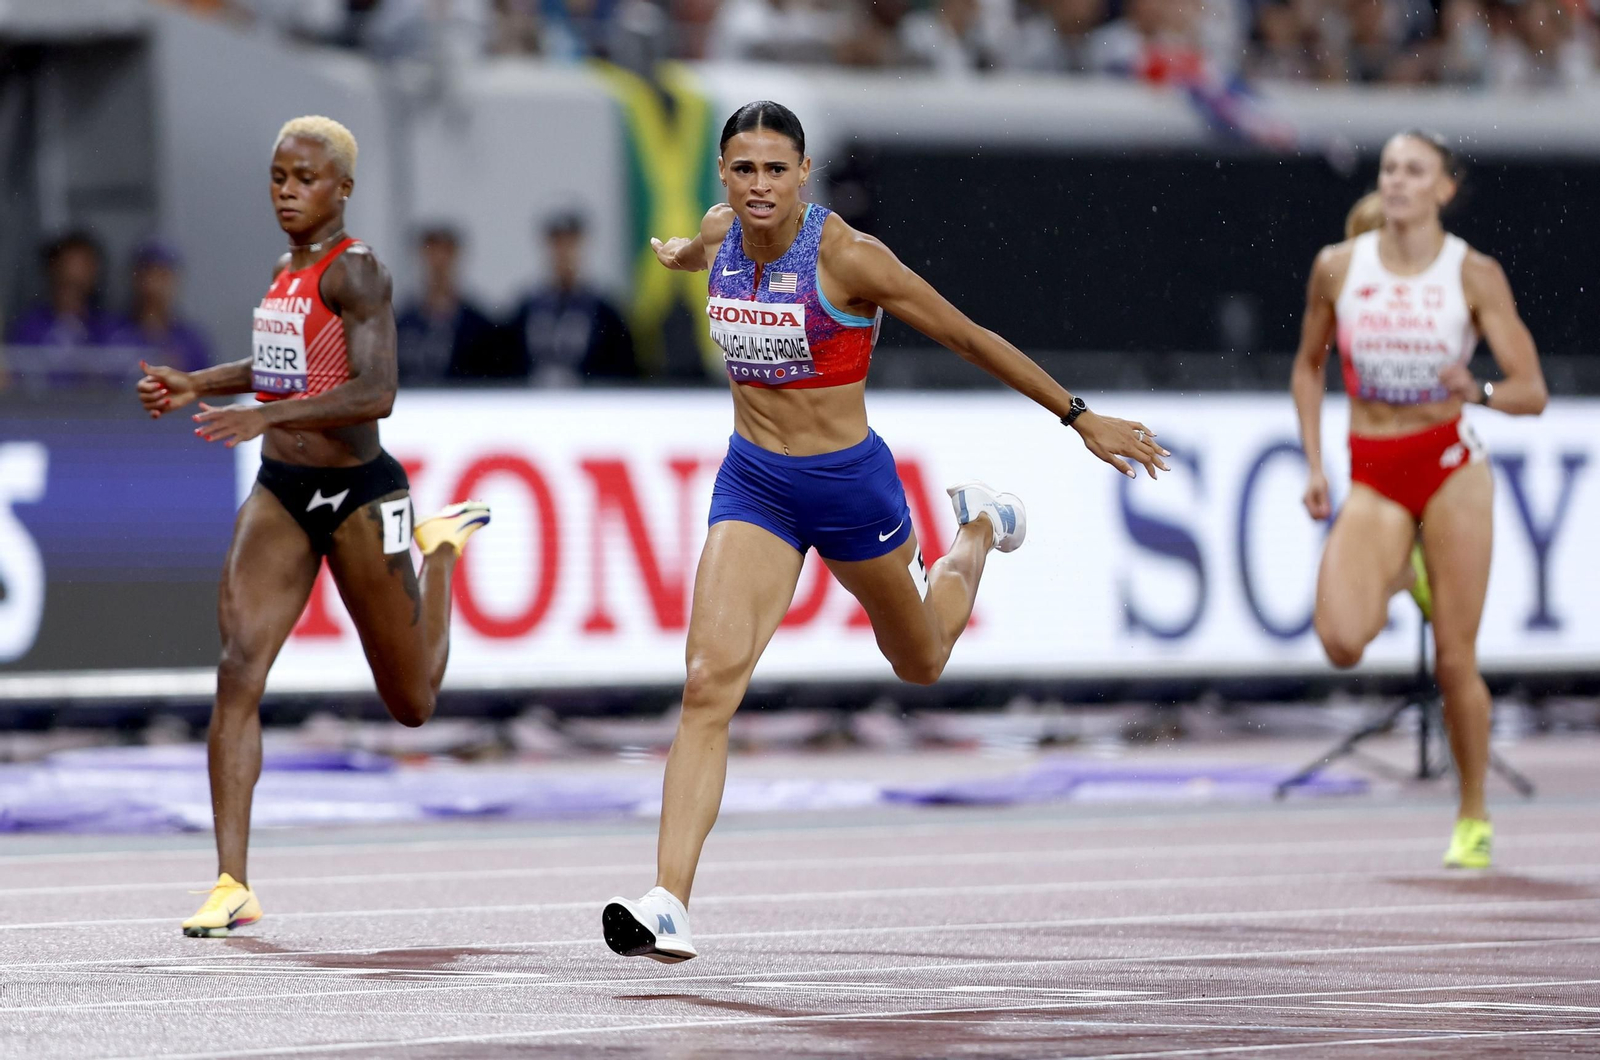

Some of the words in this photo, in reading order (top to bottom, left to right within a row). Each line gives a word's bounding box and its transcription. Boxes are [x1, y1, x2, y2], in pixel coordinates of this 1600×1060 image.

[253, 318, 300, 335] ONDA
[709, 306, 801, 327] HONDA
[256, 344, 298, 370] ASER
[790, 365, 810, 375] 25
[392, 508, 405, 543] 7
[293, 450, 977, 641] ONA
[1117, 438, 1588, 641] SOY
[656, 914, 677, 934] N
